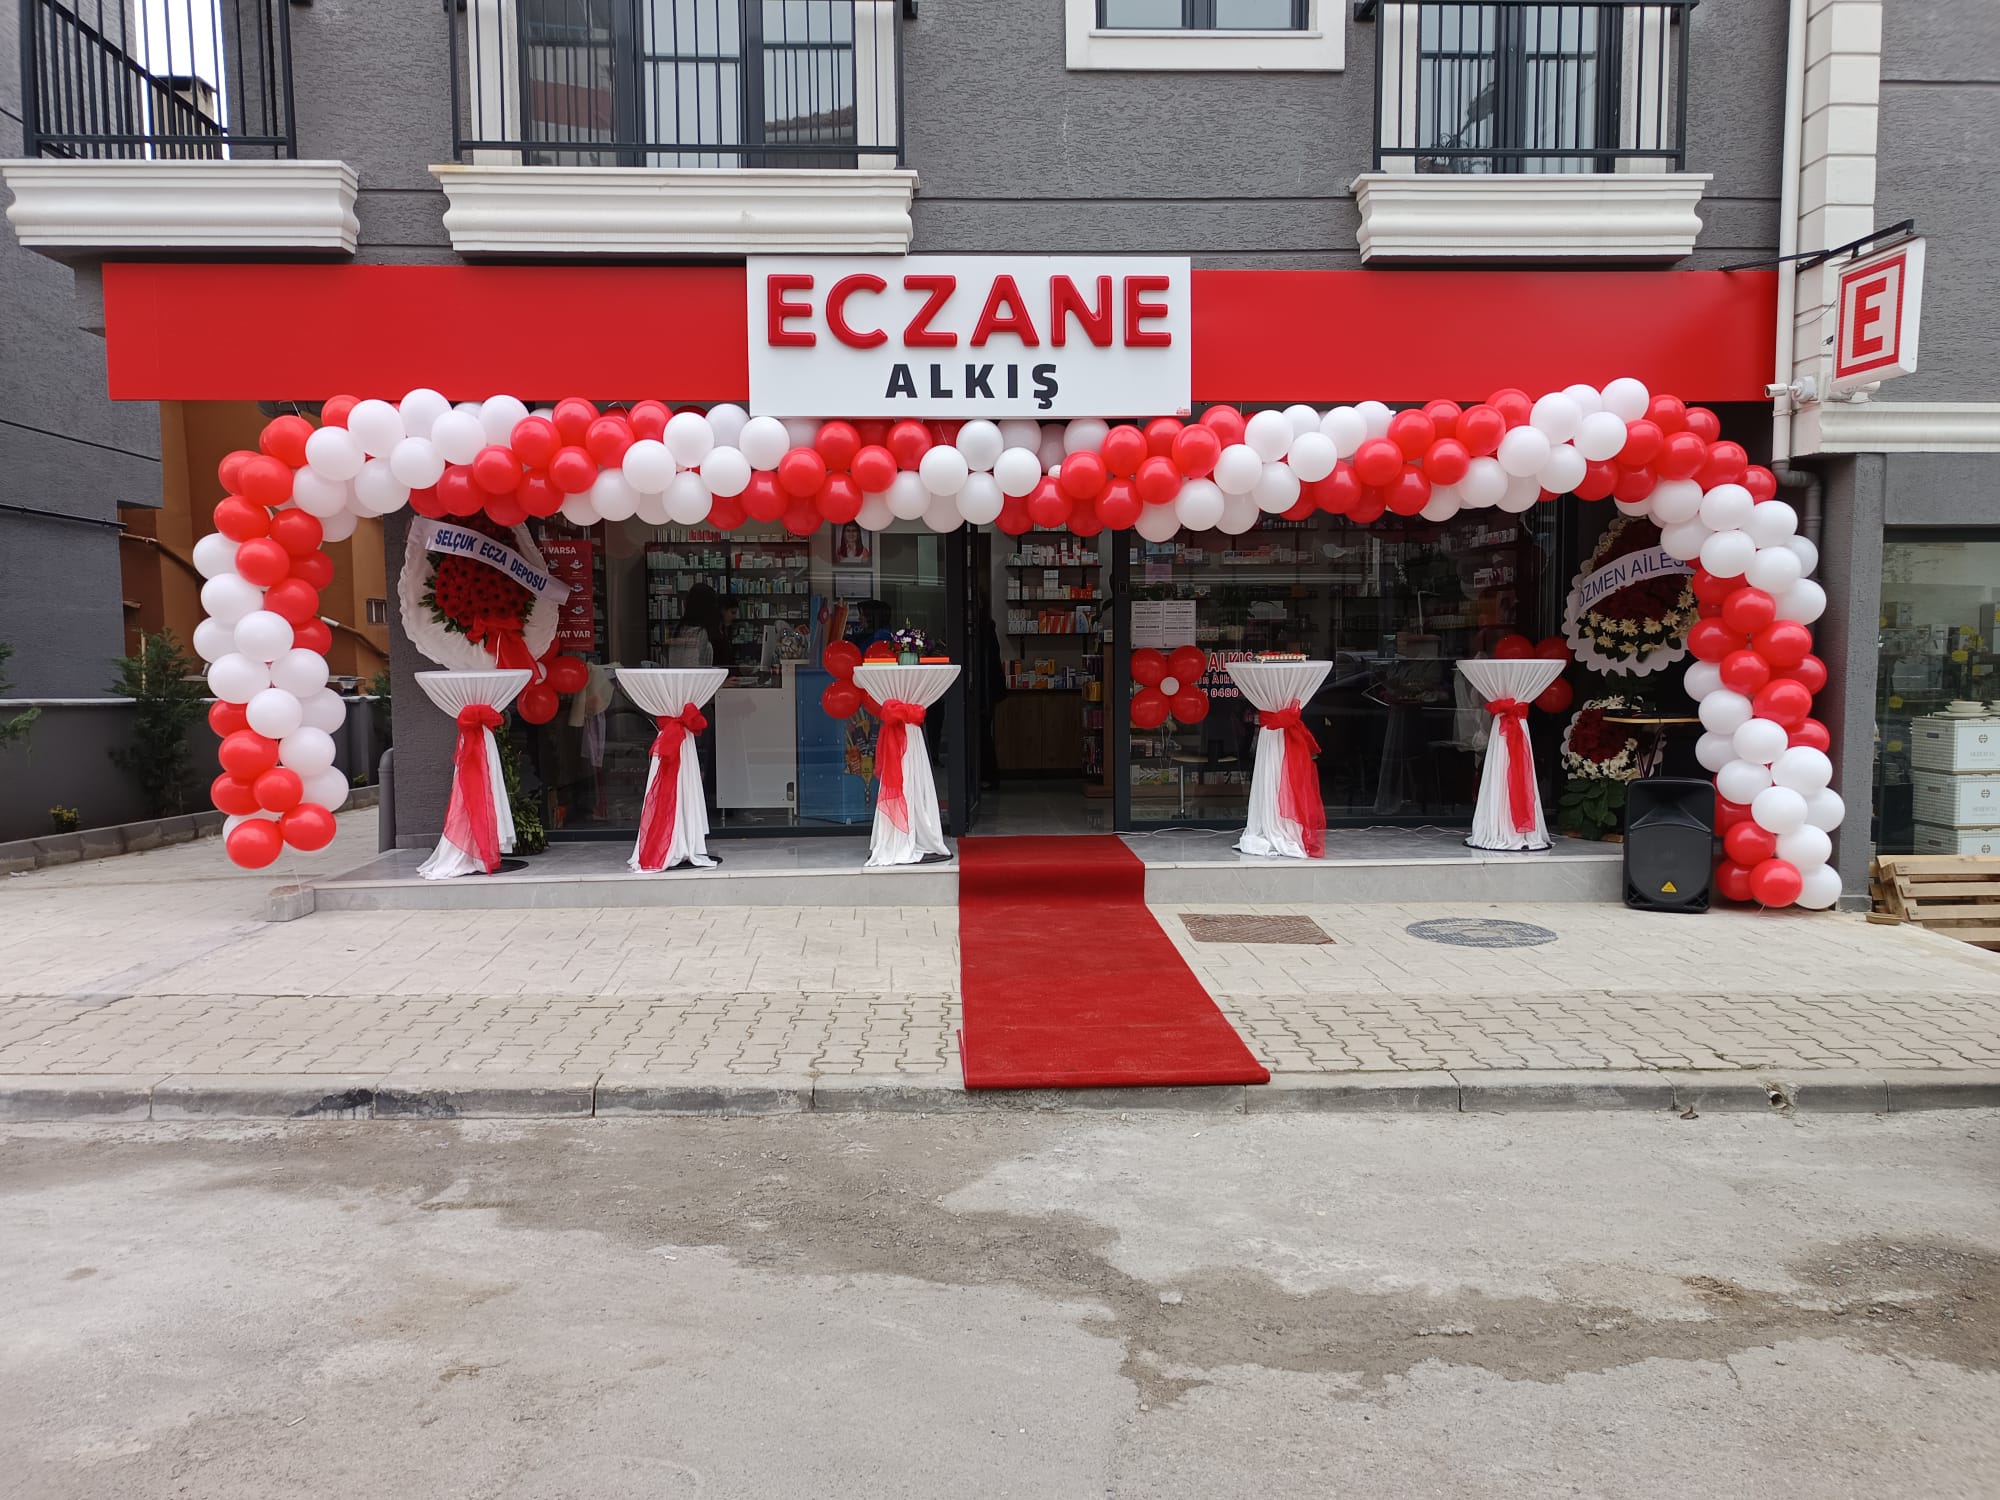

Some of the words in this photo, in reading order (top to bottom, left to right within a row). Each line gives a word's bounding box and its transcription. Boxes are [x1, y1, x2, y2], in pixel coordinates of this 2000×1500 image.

[766, 273, 1172, 350] ECZANE
[1851, 276, 1888, 359] E
[885, 363, 1059, 409] ALKIŞ
[435, 529, 477, 552] SELÇUK
[479, 542, 507, 566] ECZA
[510, 558, 548, 591] DEPOSU
[548, 546, 577, 555] VARSA
[556, 630, 572, 639] YAT
[573, 630, 591, 639] VAR
